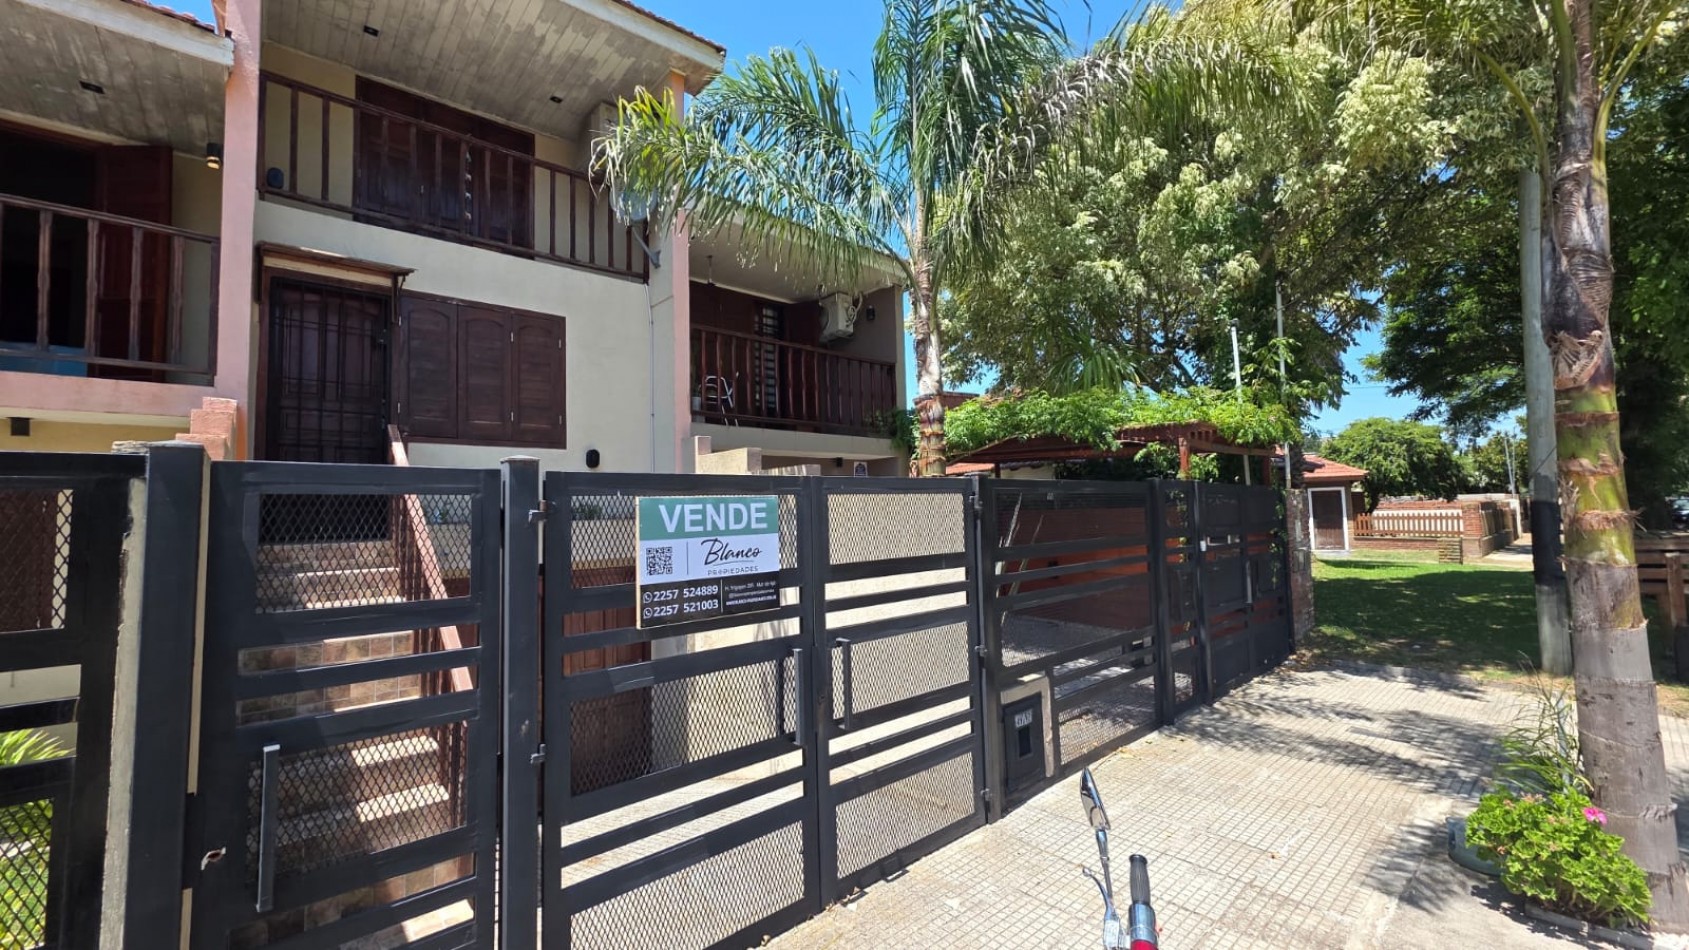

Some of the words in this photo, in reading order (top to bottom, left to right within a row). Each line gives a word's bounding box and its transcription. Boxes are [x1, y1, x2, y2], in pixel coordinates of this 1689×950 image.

[658, 502, 768, 533] VENDE
[701, 538, 762, 566] Blanco
[707, 565, 759, 576] PROPIEDADES
[653, 589, 679, 602] 2257
[683, 585, 719, 598] 524889
[653, 604, 679, 617] 2257
[683, 599, 719, 613] 521003
